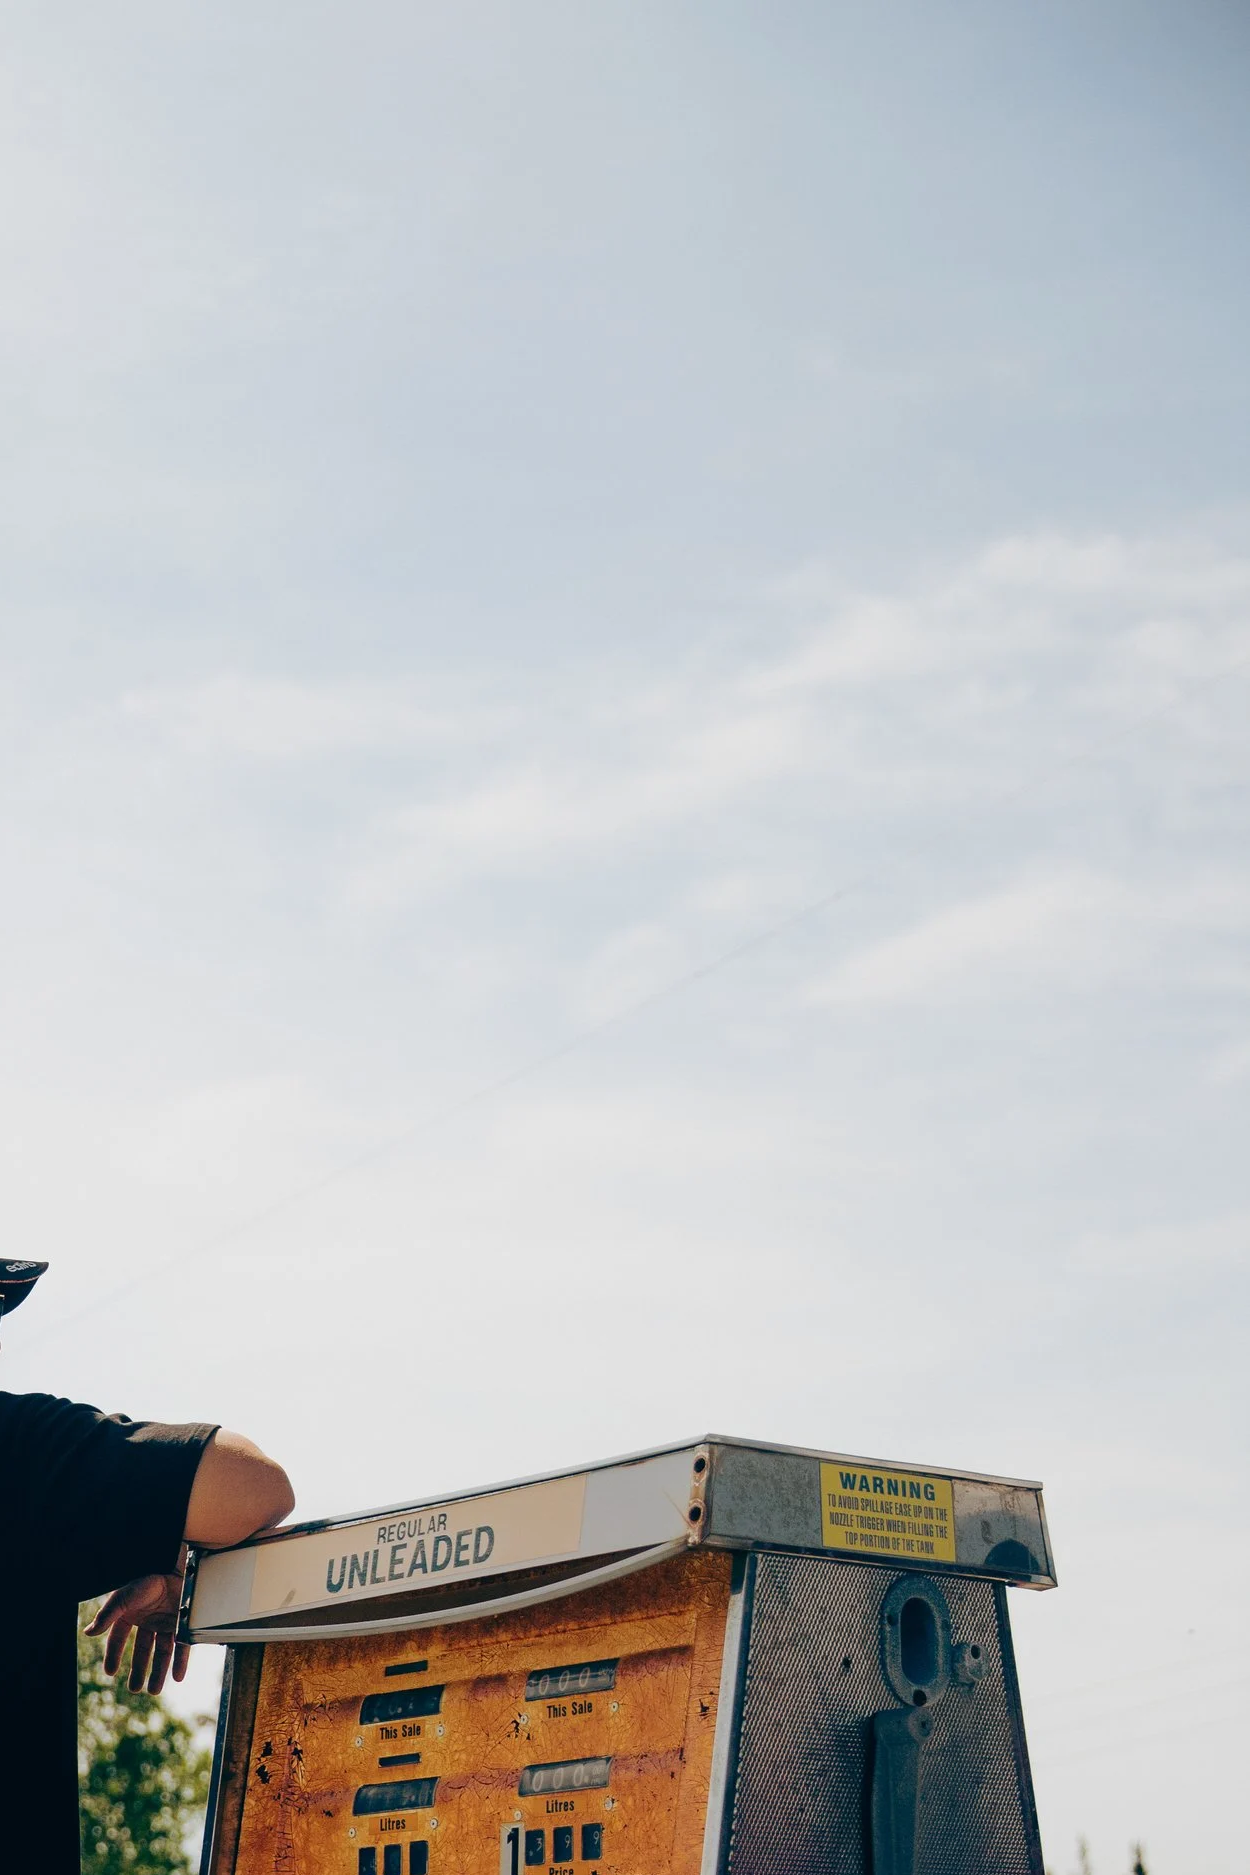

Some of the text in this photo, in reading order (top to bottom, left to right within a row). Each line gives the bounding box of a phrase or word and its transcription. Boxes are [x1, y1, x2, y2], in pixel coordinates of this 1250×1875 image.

[838, 1471, 936, 1502] WARNING
[827, 1493, 948, 1522] TO AVOID SPILLAGE EASE UP ON THE
[377, 1513, 448, 1545] REGULAR
[829, 1512, 948, 1539] NOZZLE TRIGGER WHEN FILLING THE
[845, 1531, 935, 1555] TOP PORTION OF THE TANK
[326, 1525, 495, 1594] UNLEADED
[546, 1700, 593, 1718] This Sale
[379, 1723, 421, 1740] This Sale
[546, 1799, 575, 1814] Litres
[379, 1817, 406, 1832] Litres
